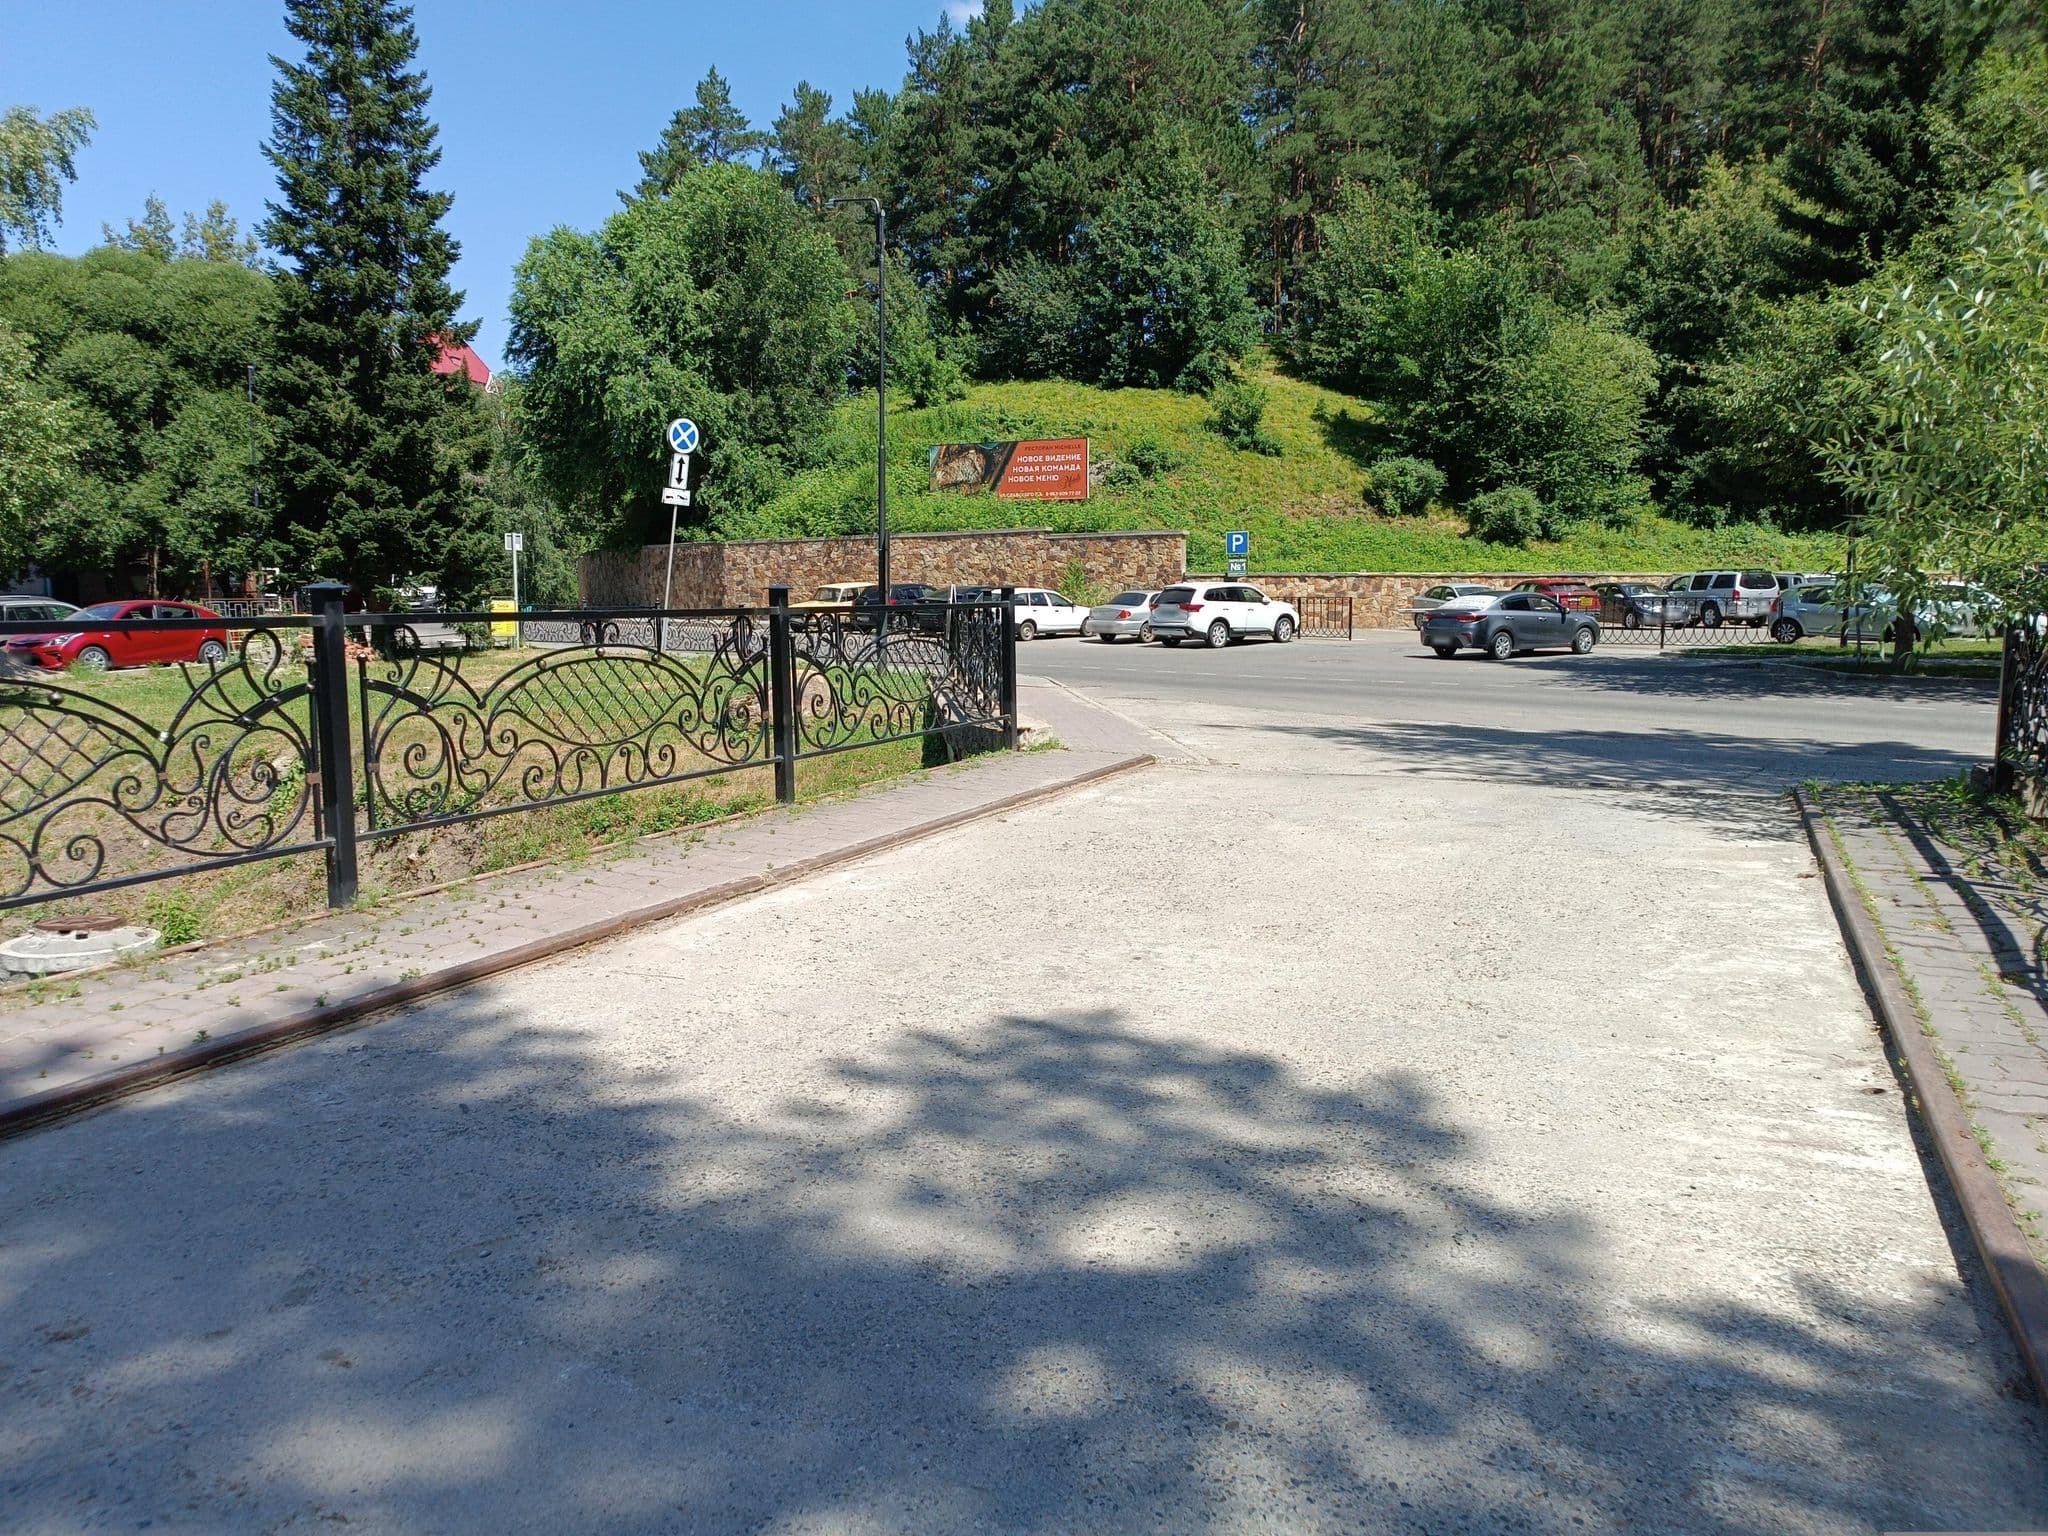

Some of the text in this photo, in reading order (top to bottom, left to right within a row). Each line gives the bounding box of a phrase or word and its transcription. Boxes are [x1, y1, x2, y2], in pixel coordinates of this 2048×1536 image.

[1017, 453, 1081, 463] НОВОЕ ВИДЕНИЕ
[1013, 464, 1081, 473] НОВАЯ КОМАНДА
[1008, 475, 1034, 483] НОВОЕ
[1036, 474, 1059, 482] МЕНЮ
[1232, 534, 1244, 552] P
